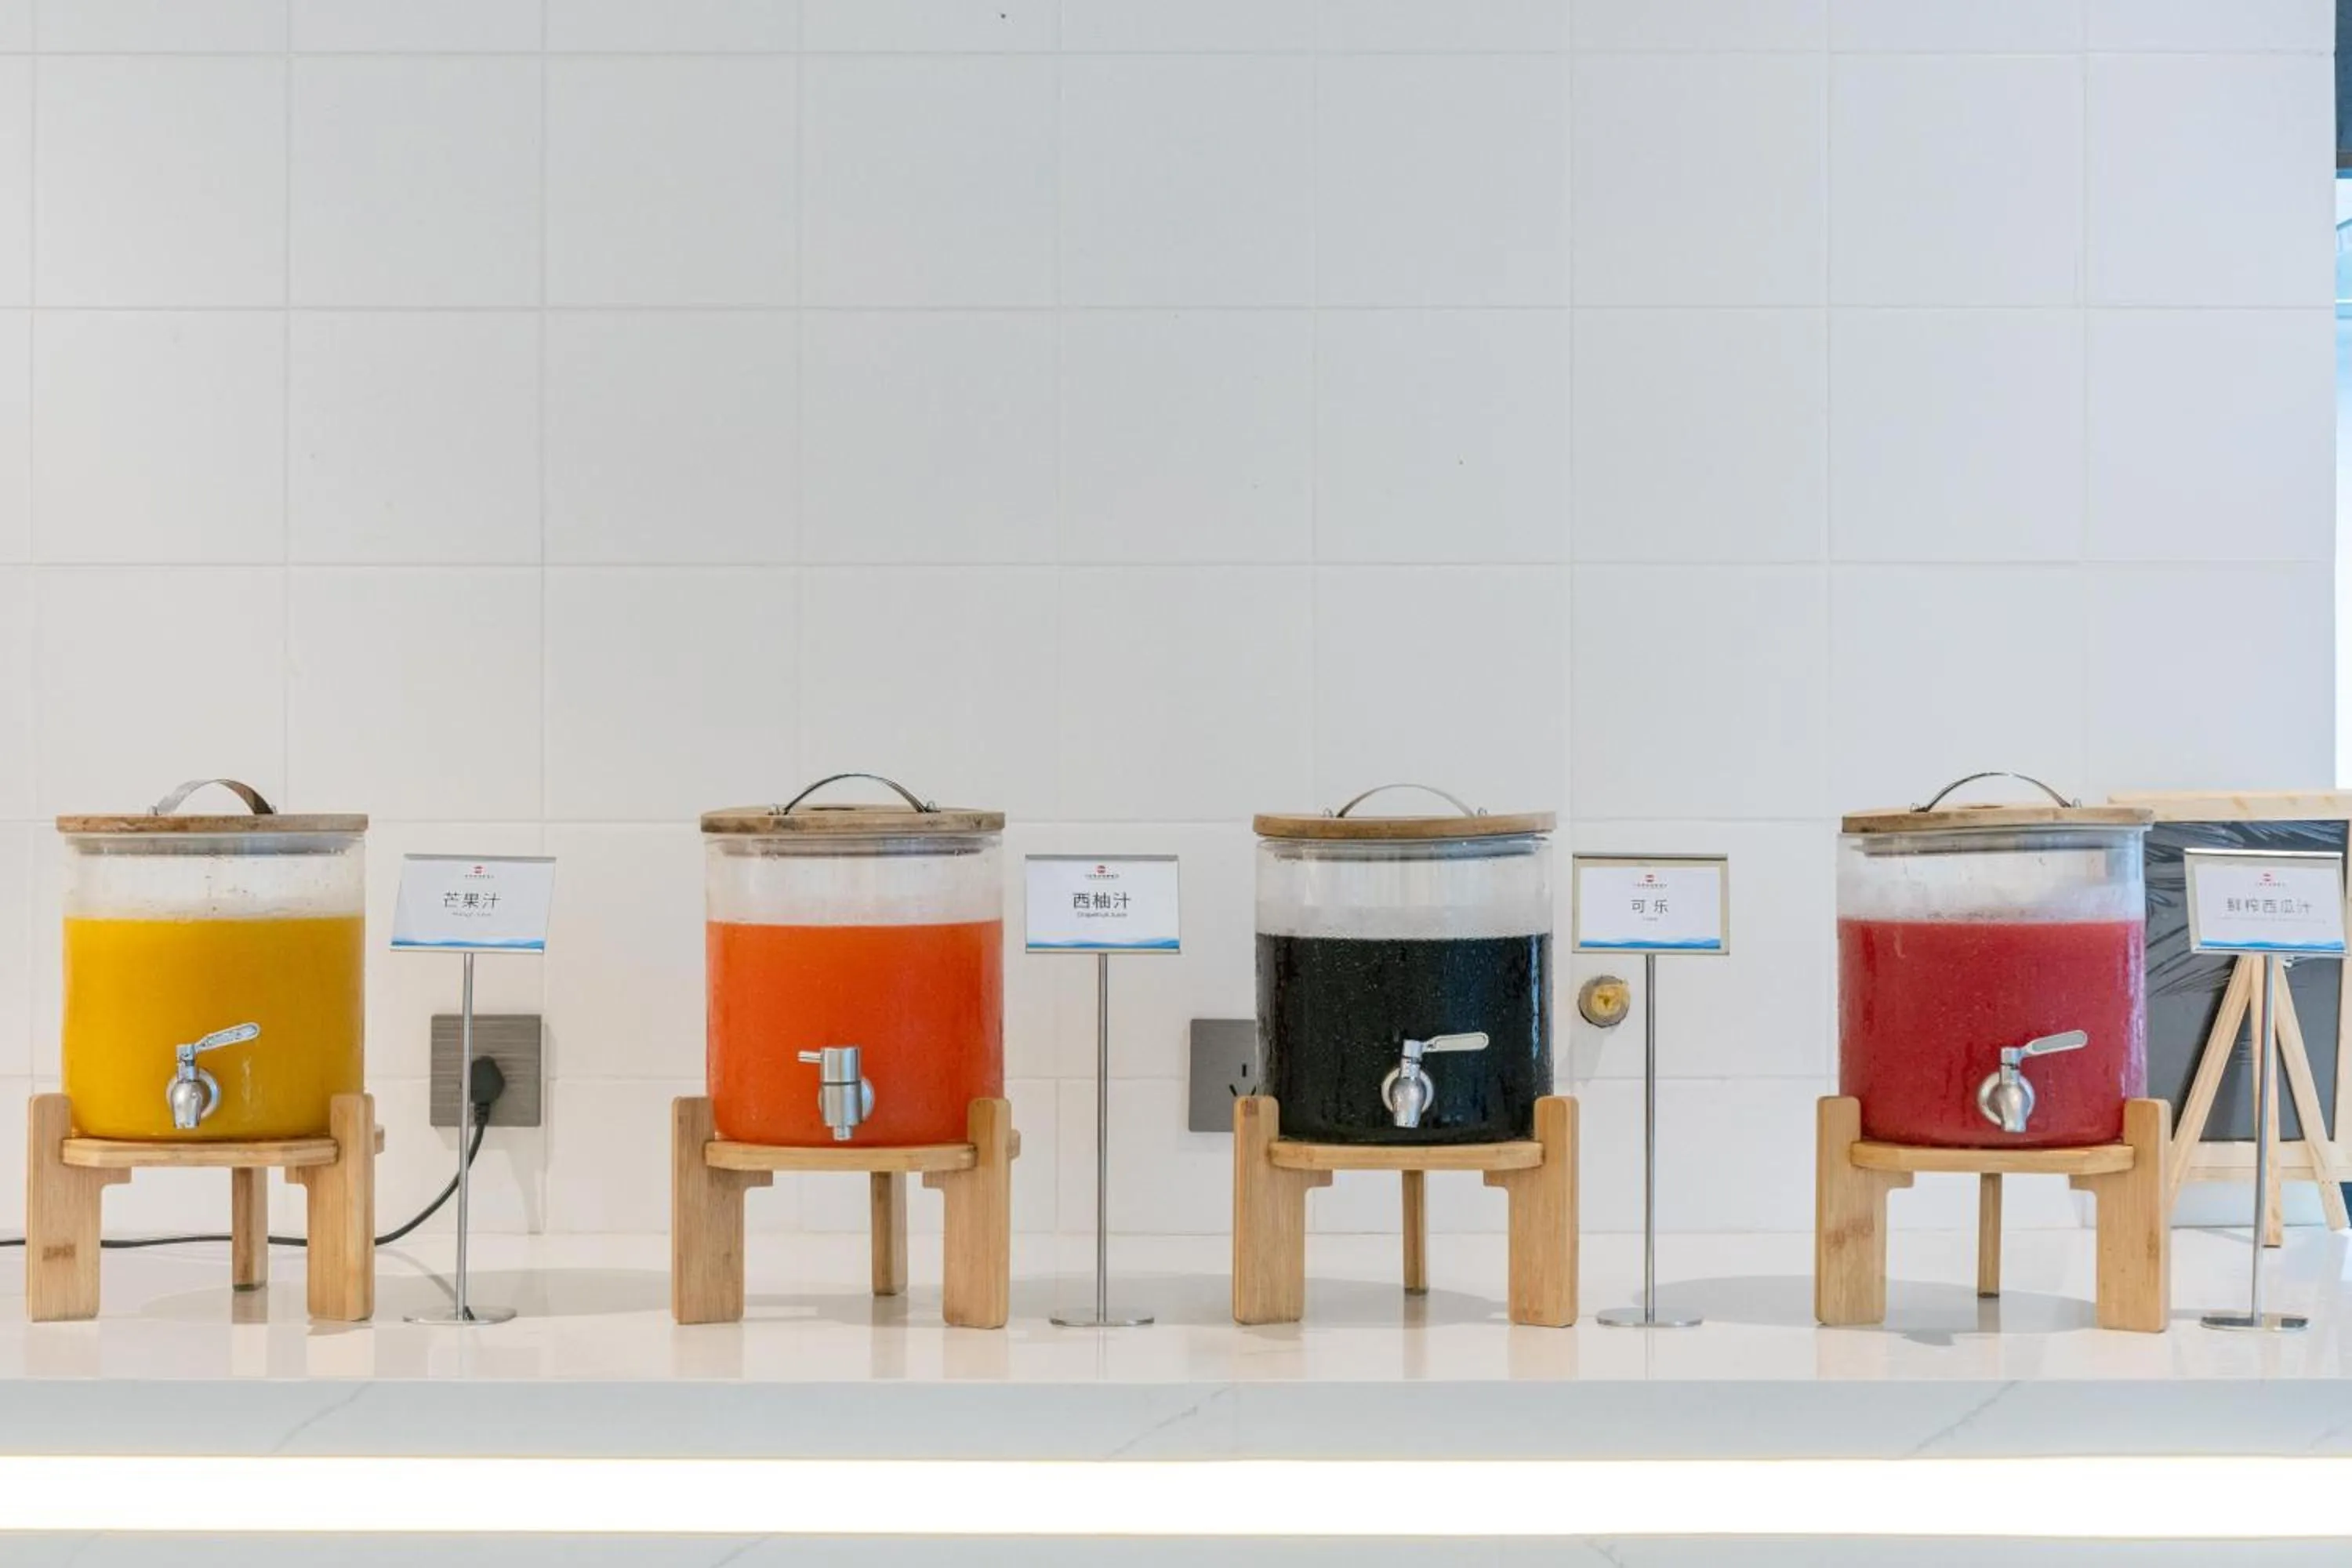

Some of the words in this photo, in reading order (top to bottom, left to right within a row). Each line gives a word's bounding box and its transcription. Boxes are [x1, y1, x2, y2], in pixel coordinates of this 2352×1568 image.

[443, 891, 502, 909] 芒果汁
[1073, 891, 1131, 909] 西柚汁
[1631, 898, 1669, 913] 可乐
[2227, 898, 2313, 915] 鲜榨西瓜汁
